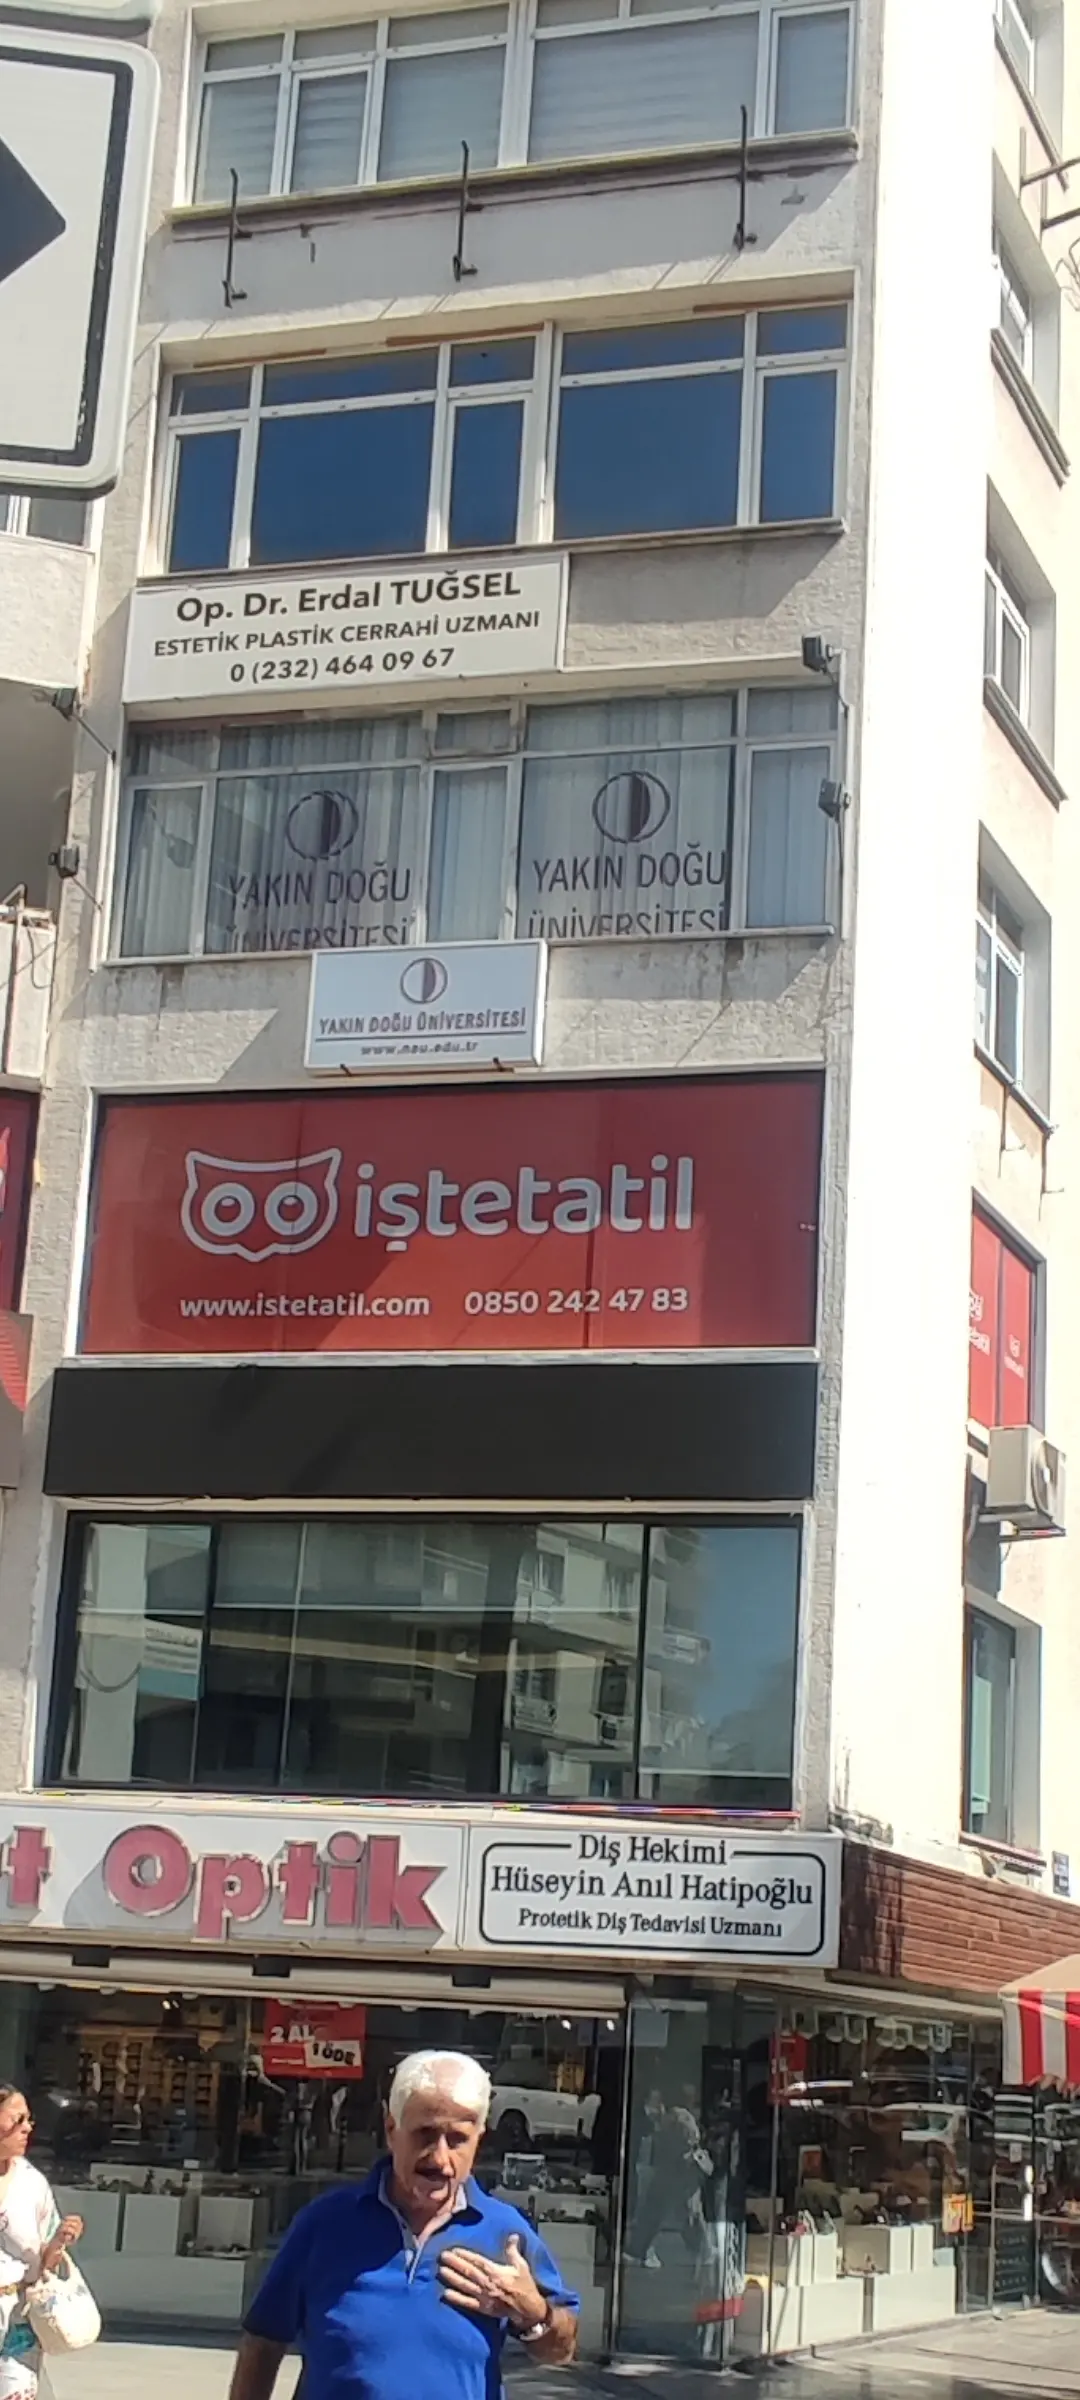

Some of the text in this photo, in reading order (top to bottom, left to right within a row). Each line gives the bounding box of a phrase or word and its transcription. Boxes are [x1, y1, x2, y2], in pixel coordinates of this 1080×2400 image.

[177, 569, 522, 627] Op. Dr. Erdal TUĞSEL
[153, 610, 540, 658] ESTETİK PLASTİK CERRAHİ UZMANI
[229, 647, 456, 684] 0 (232) 464 09 67
[229, 860, 411, 909] YAKIN DOĞU
[533, 841, 726, 893] YAKIN DOĞU
[319, 1007, 526, 1035] YAKIN DOĞU ÜNİVERSİTESİ
[353, 1154, 695, 1252] iştetatil
[179, 1286, 690, 1318] www.istetatil.com 0850 242 47 83
[578, 1834, 728, 1867] Diş Hekimi
[102, 1824, 448, 1941] Optik
[491, 1864, 814, 1909] Hüseyin Anıl Hatipoğlu
[518, 1907, 782, 1937] Protetik Diş Tedavisi Uzmanı
[270, 2024, 315, 2043] 2 AL
